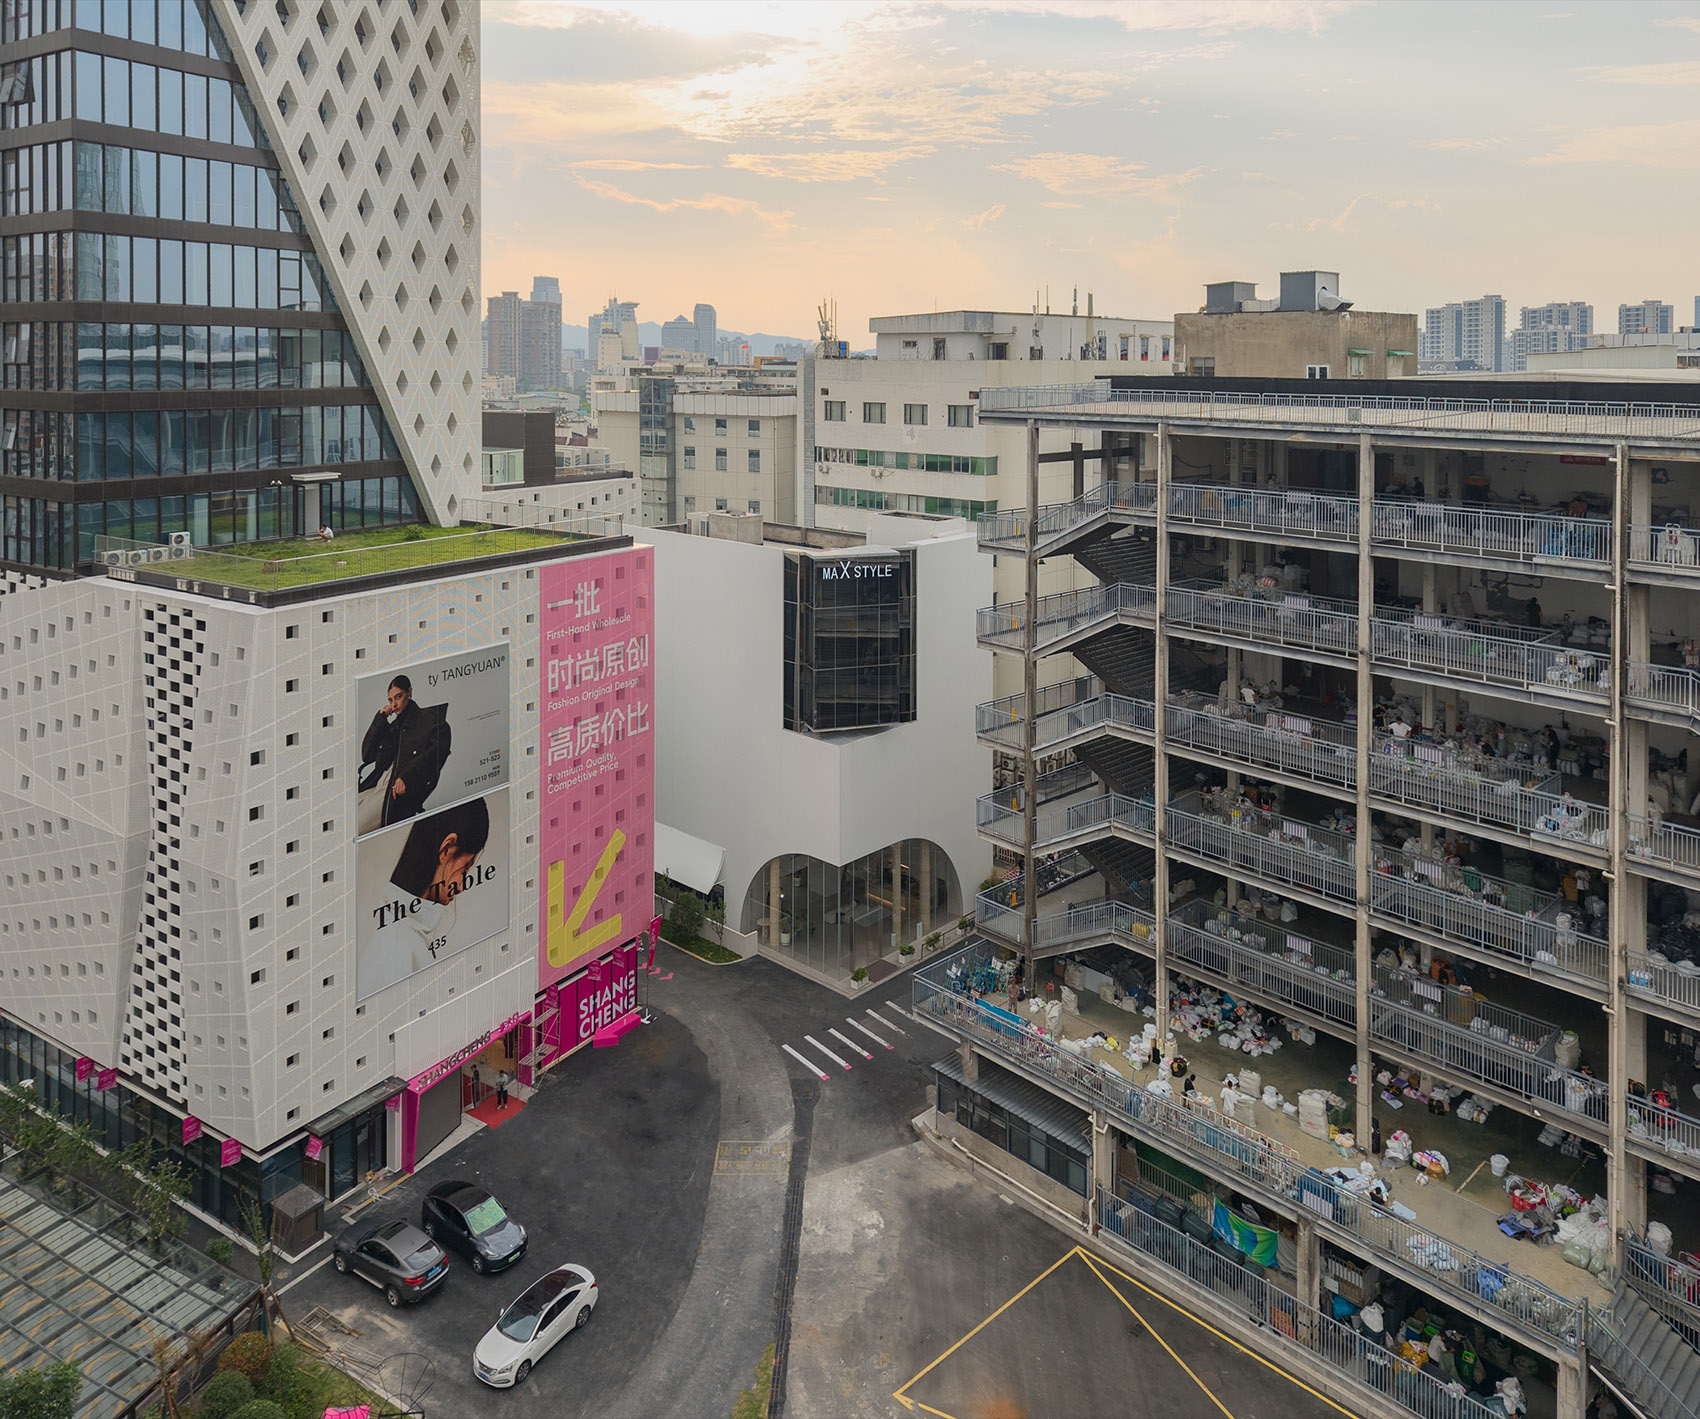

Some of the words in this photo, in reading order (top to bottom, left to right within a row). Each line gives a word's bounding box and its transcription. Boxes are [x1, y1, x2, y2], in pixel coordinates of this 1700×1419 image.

[823, 561, 850, 579] MAX
[854, 564, 892, 578] STYLE
[547, 579, 600, 618] 一批
[547, 623, 590, 640] First-Hand
[593, 613, 631, 630] Wholesale
[428, 674, 440, 687] ty
[548, 634, 649, 693] 时尚原创
[547, 690, 580, 712] Fashion
[582, 684, 613, 703] Original
[615, 676, 641, 694] Design
[548, 701, 650, 767] 高质价比
[547, 762, 584, 784] Premium
[547, 771, 598, 795] Competitive
[599, 760, 619, 776] Price
[373, 896, 422, 930] The
[429, 865, 496, 904] Table
[428, 935, 447, 955] 435
[579, 969, 635, 1019] SHANG
[579, 989, 635, 1038] CHENG
[417, 1030, 491, 1089] SHANGCHENG
